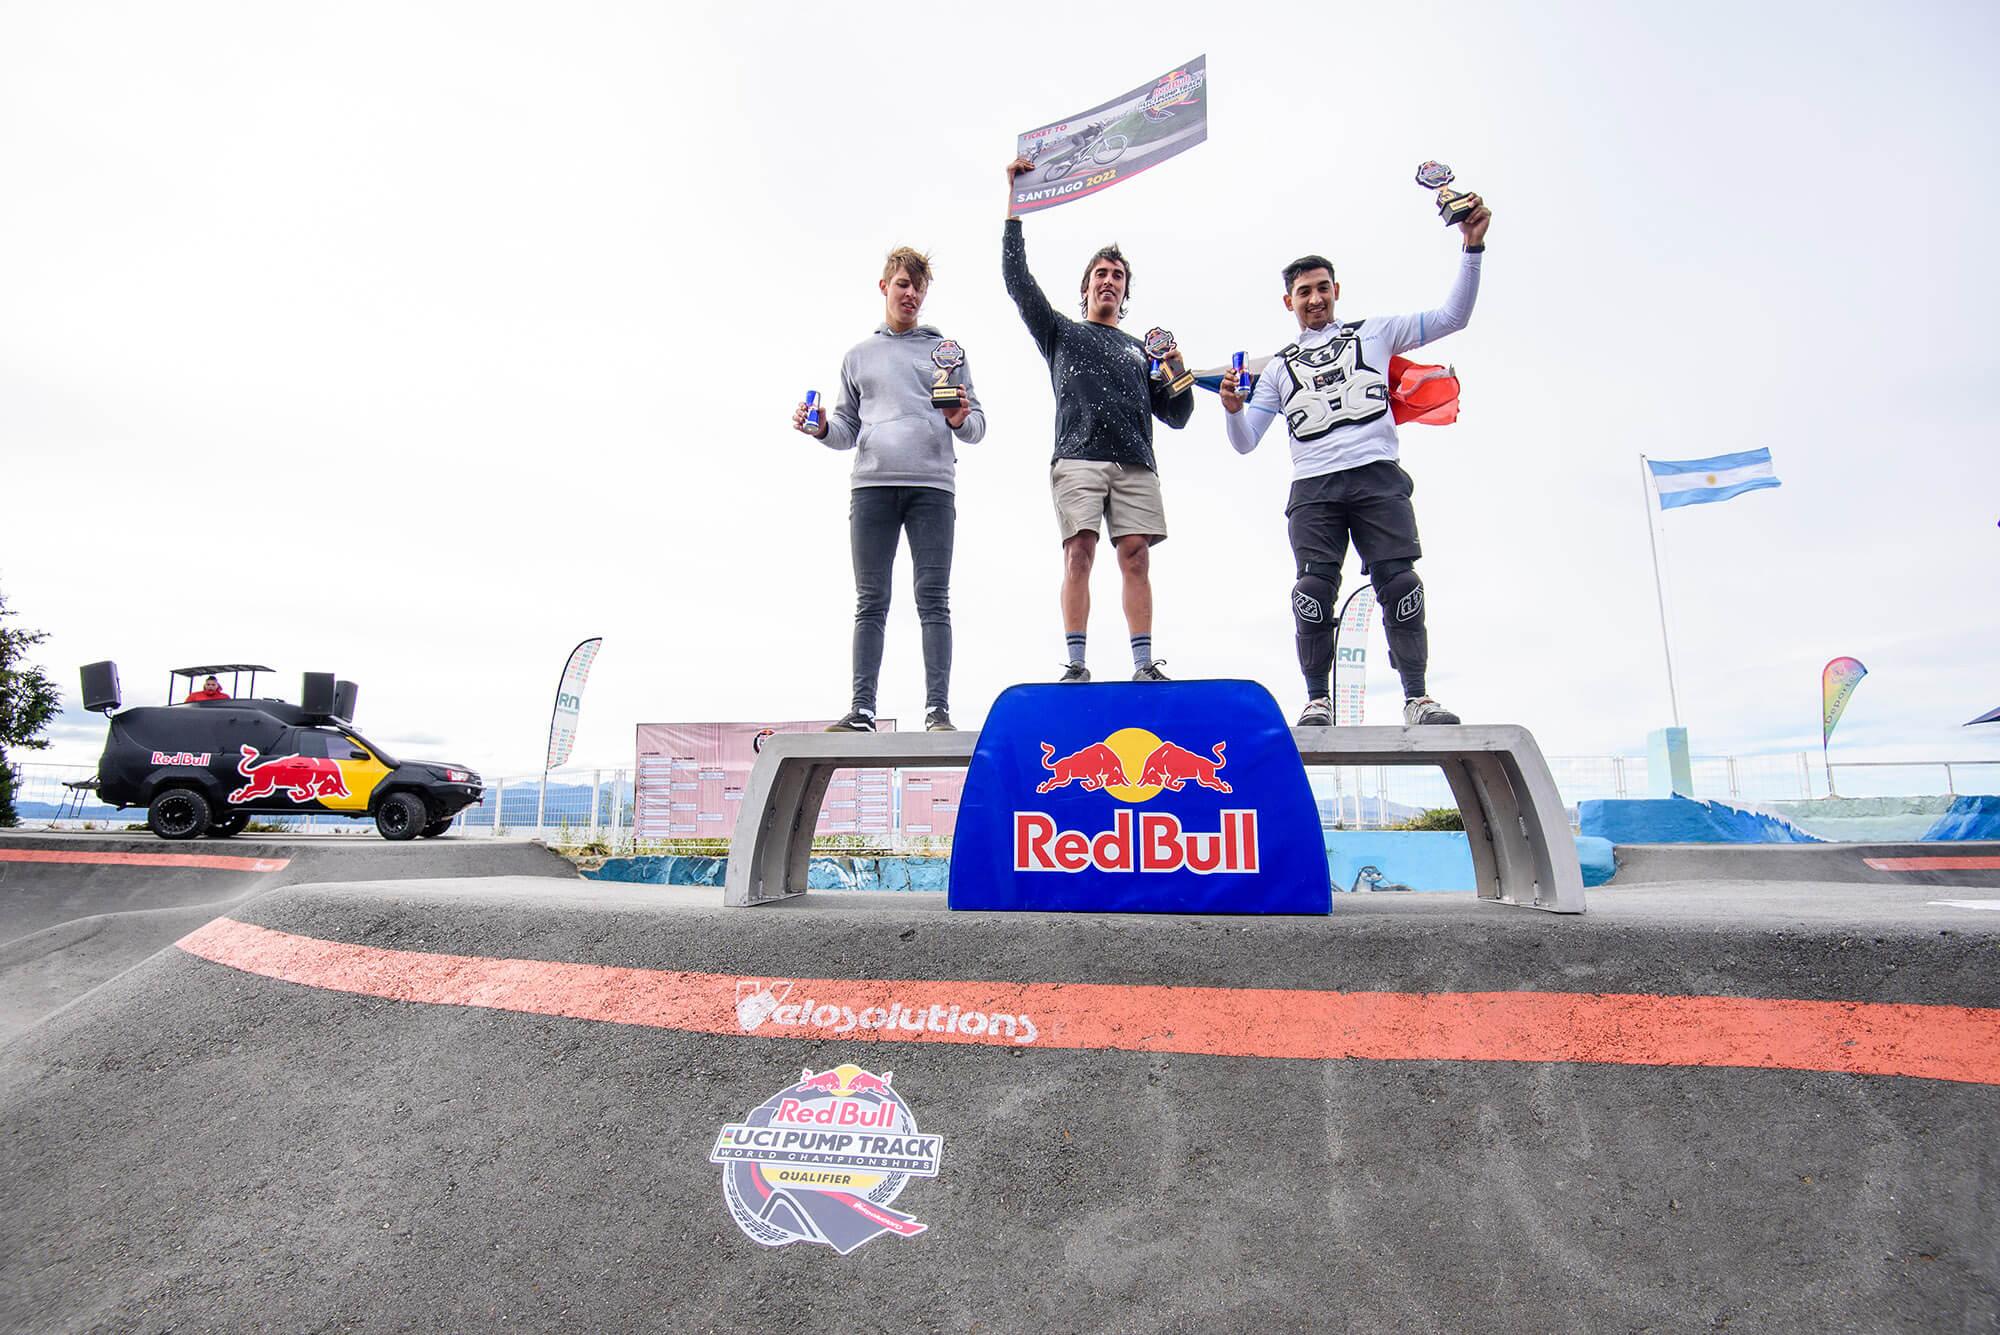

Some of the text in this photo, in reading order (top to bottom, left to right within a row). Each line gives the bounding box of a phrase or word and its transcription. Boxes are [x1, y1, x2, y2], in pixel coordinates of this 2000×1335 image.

[1153, 74, 1190, 96] Red Bull
[1157, 89, 1178, 101] PUMP
[1179, 78, 1202, 92] TRACK
[1023, 124, 1067, 141] TICKET TO
[1017, 169, 1117, 203] SANTIAGO 2022
[934, 369, 948, 386] 2
[151, 751, 211, 766] Red Bull
[1014, 808, 1260, 875] Red Bull
[777, 1099, 896, 1128] Red Bull
[733, 1129, 935, 1159] UCI PUMP TRACK
[721, 1149, 931, 1170] WORLD CHAMPIONSHIPS
[779, 1171, 852, 1185] QUALIFIER
